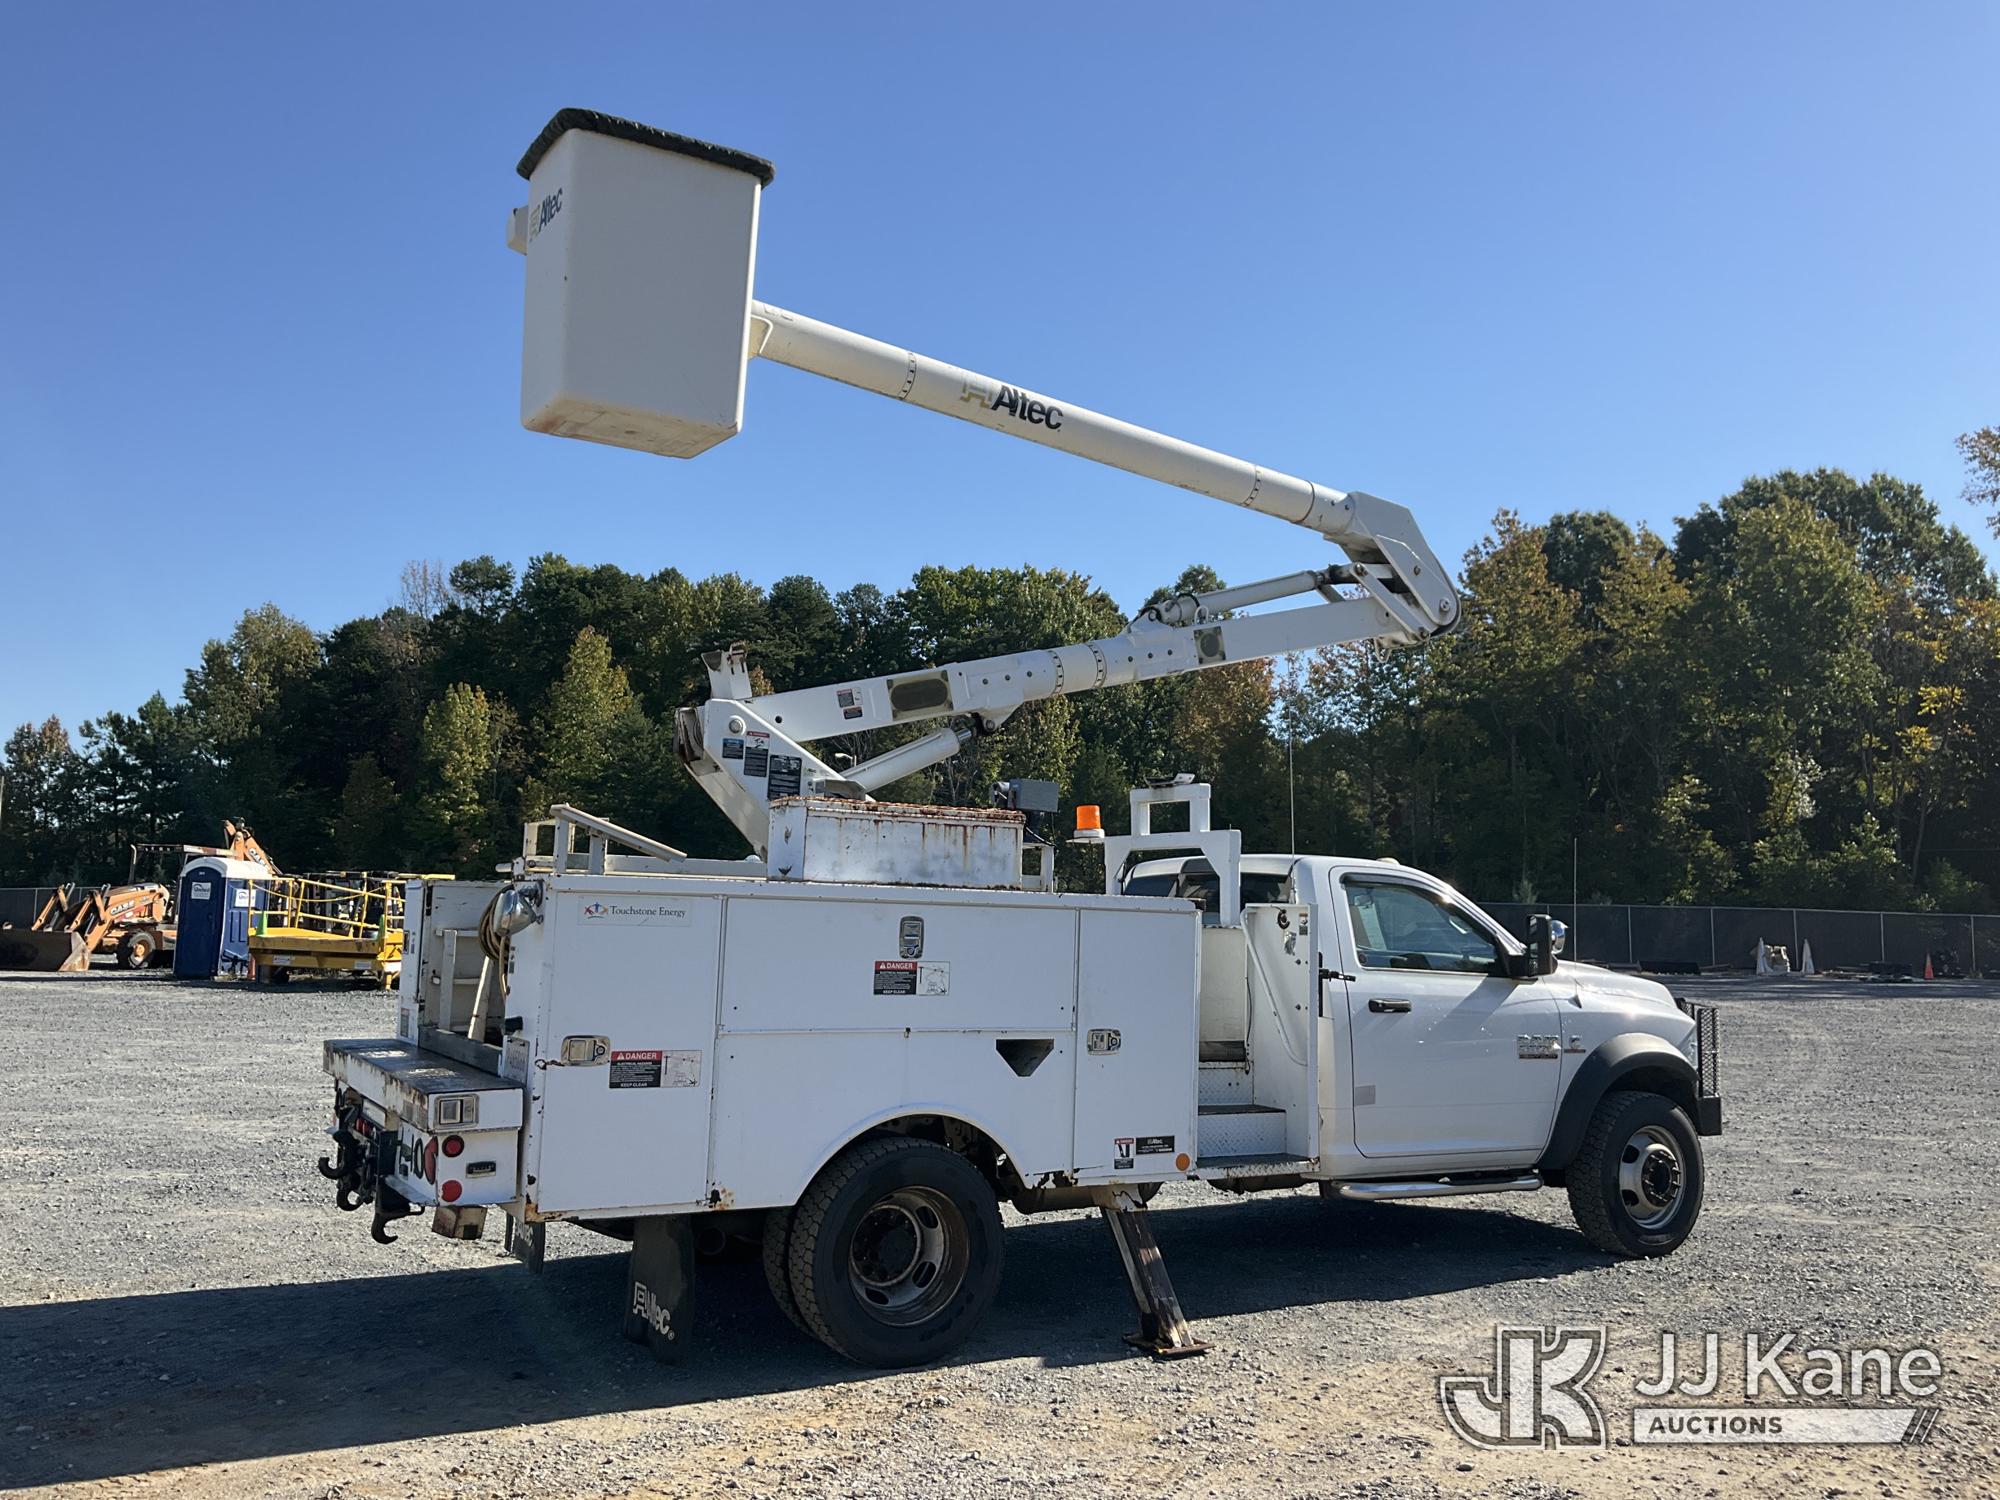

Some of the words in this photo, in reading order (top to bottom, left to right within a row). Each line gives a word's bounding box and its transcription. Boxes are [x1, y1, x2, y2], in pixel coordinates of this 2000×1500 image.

[538, 188, 562, 232] Altec
[991, 384, 1064, 430] Altec
[610, 905, 657, 917] Touchstone
[659, 906, 686, 918] Energy
[886, 962, 913, 970] DANGER
[625, 1052, 657, 1060] DANGER
